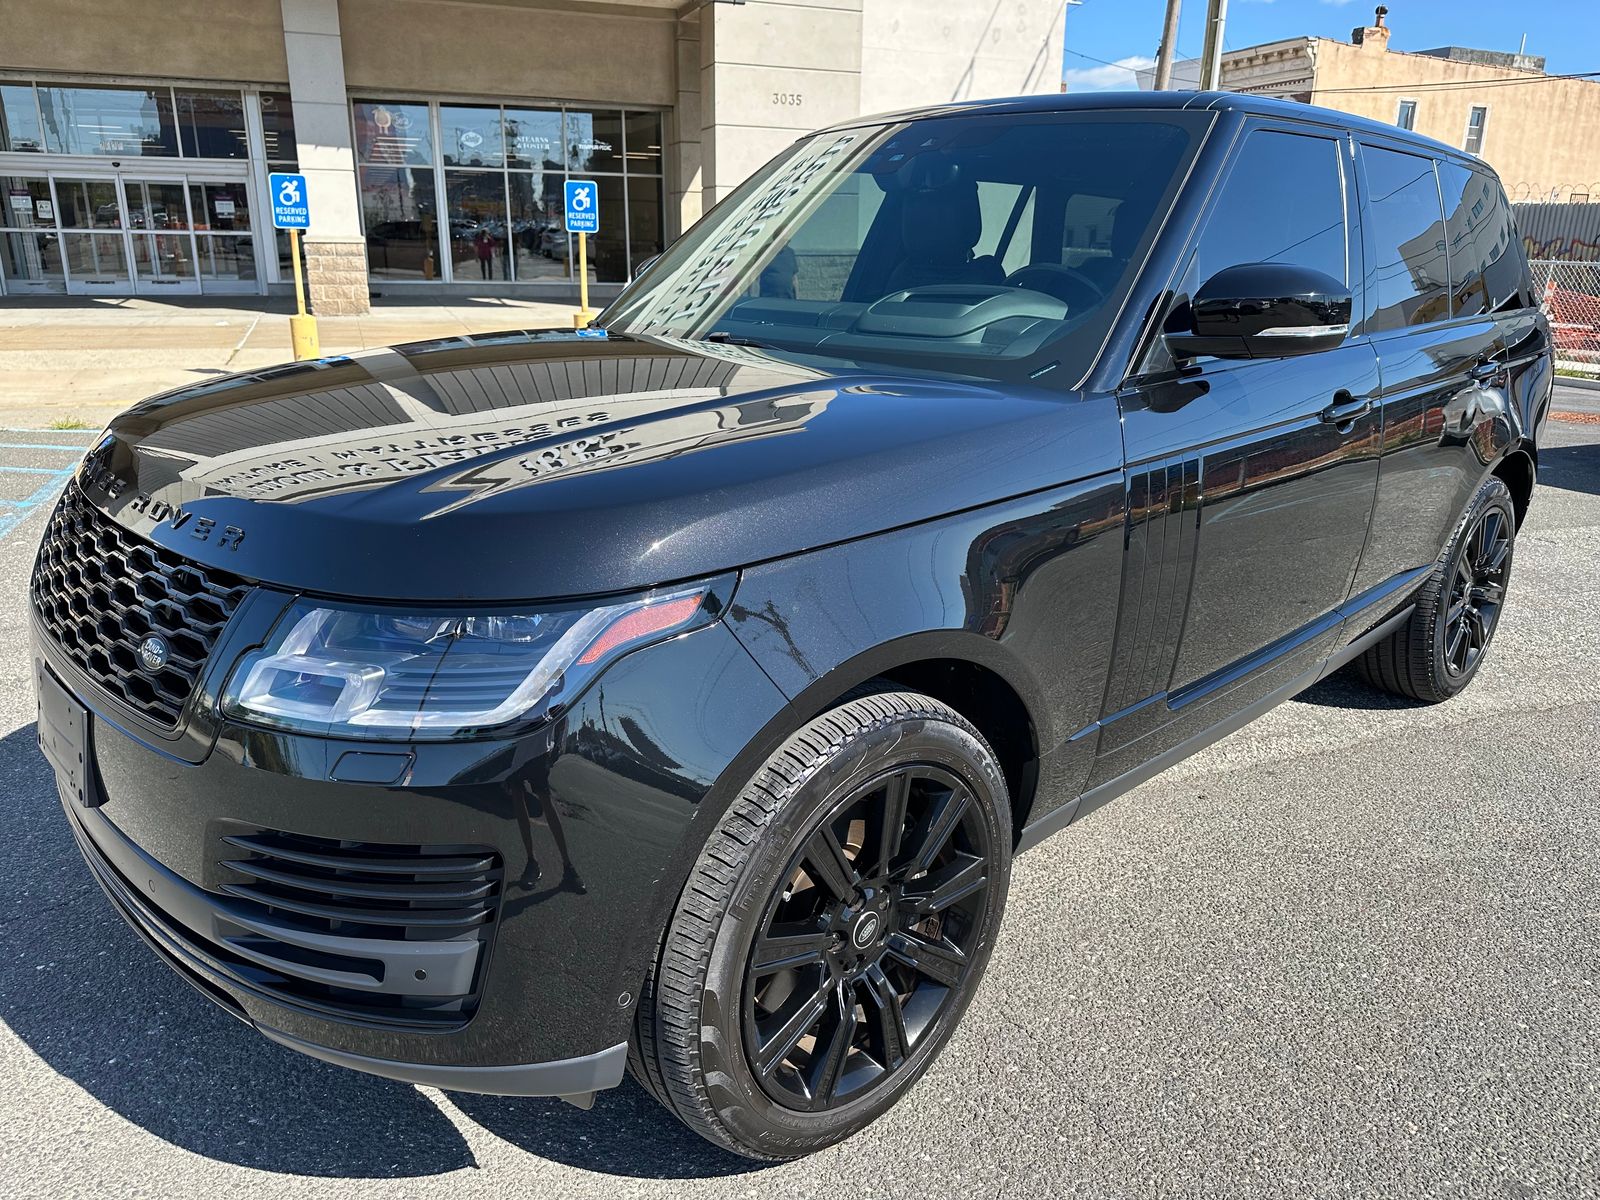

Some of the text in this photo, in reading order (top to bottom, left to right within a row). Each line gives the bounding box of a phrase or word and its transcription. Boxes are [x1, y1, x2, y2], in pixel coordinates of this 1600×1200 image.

[772, 93, 802, 106] 3035
[275, 206, 307, 215] RESERVED
[278, 215, 306, 223] PARKING
[568, 212, 595, 220] RESERVED
[570, 220, 594, 228] PARKING
[131, 491, 246, 551] ROVER
[144, 639, 161, 654] LAND
